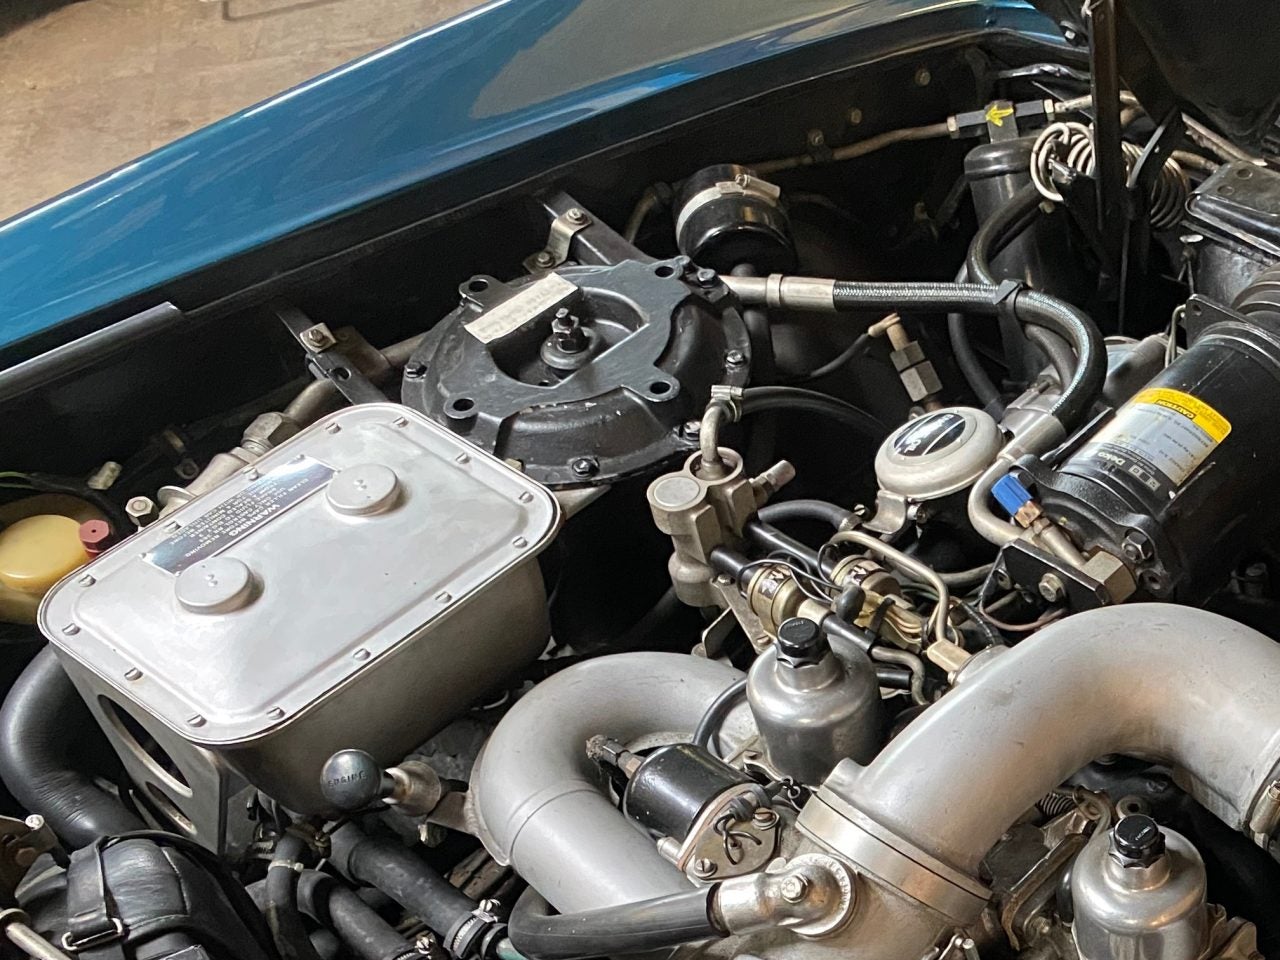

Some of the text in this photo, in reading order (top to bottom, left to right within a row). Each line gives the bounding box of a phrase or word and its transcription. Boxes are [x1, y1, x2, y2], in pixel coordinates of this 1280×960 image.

[1156, 398, 1195, 419] CAUTION
[1097, 450, 1125, 466] Delco
[226, 501, 281, 538] WARNING
[183, 533, 220, 557] REMOVING
